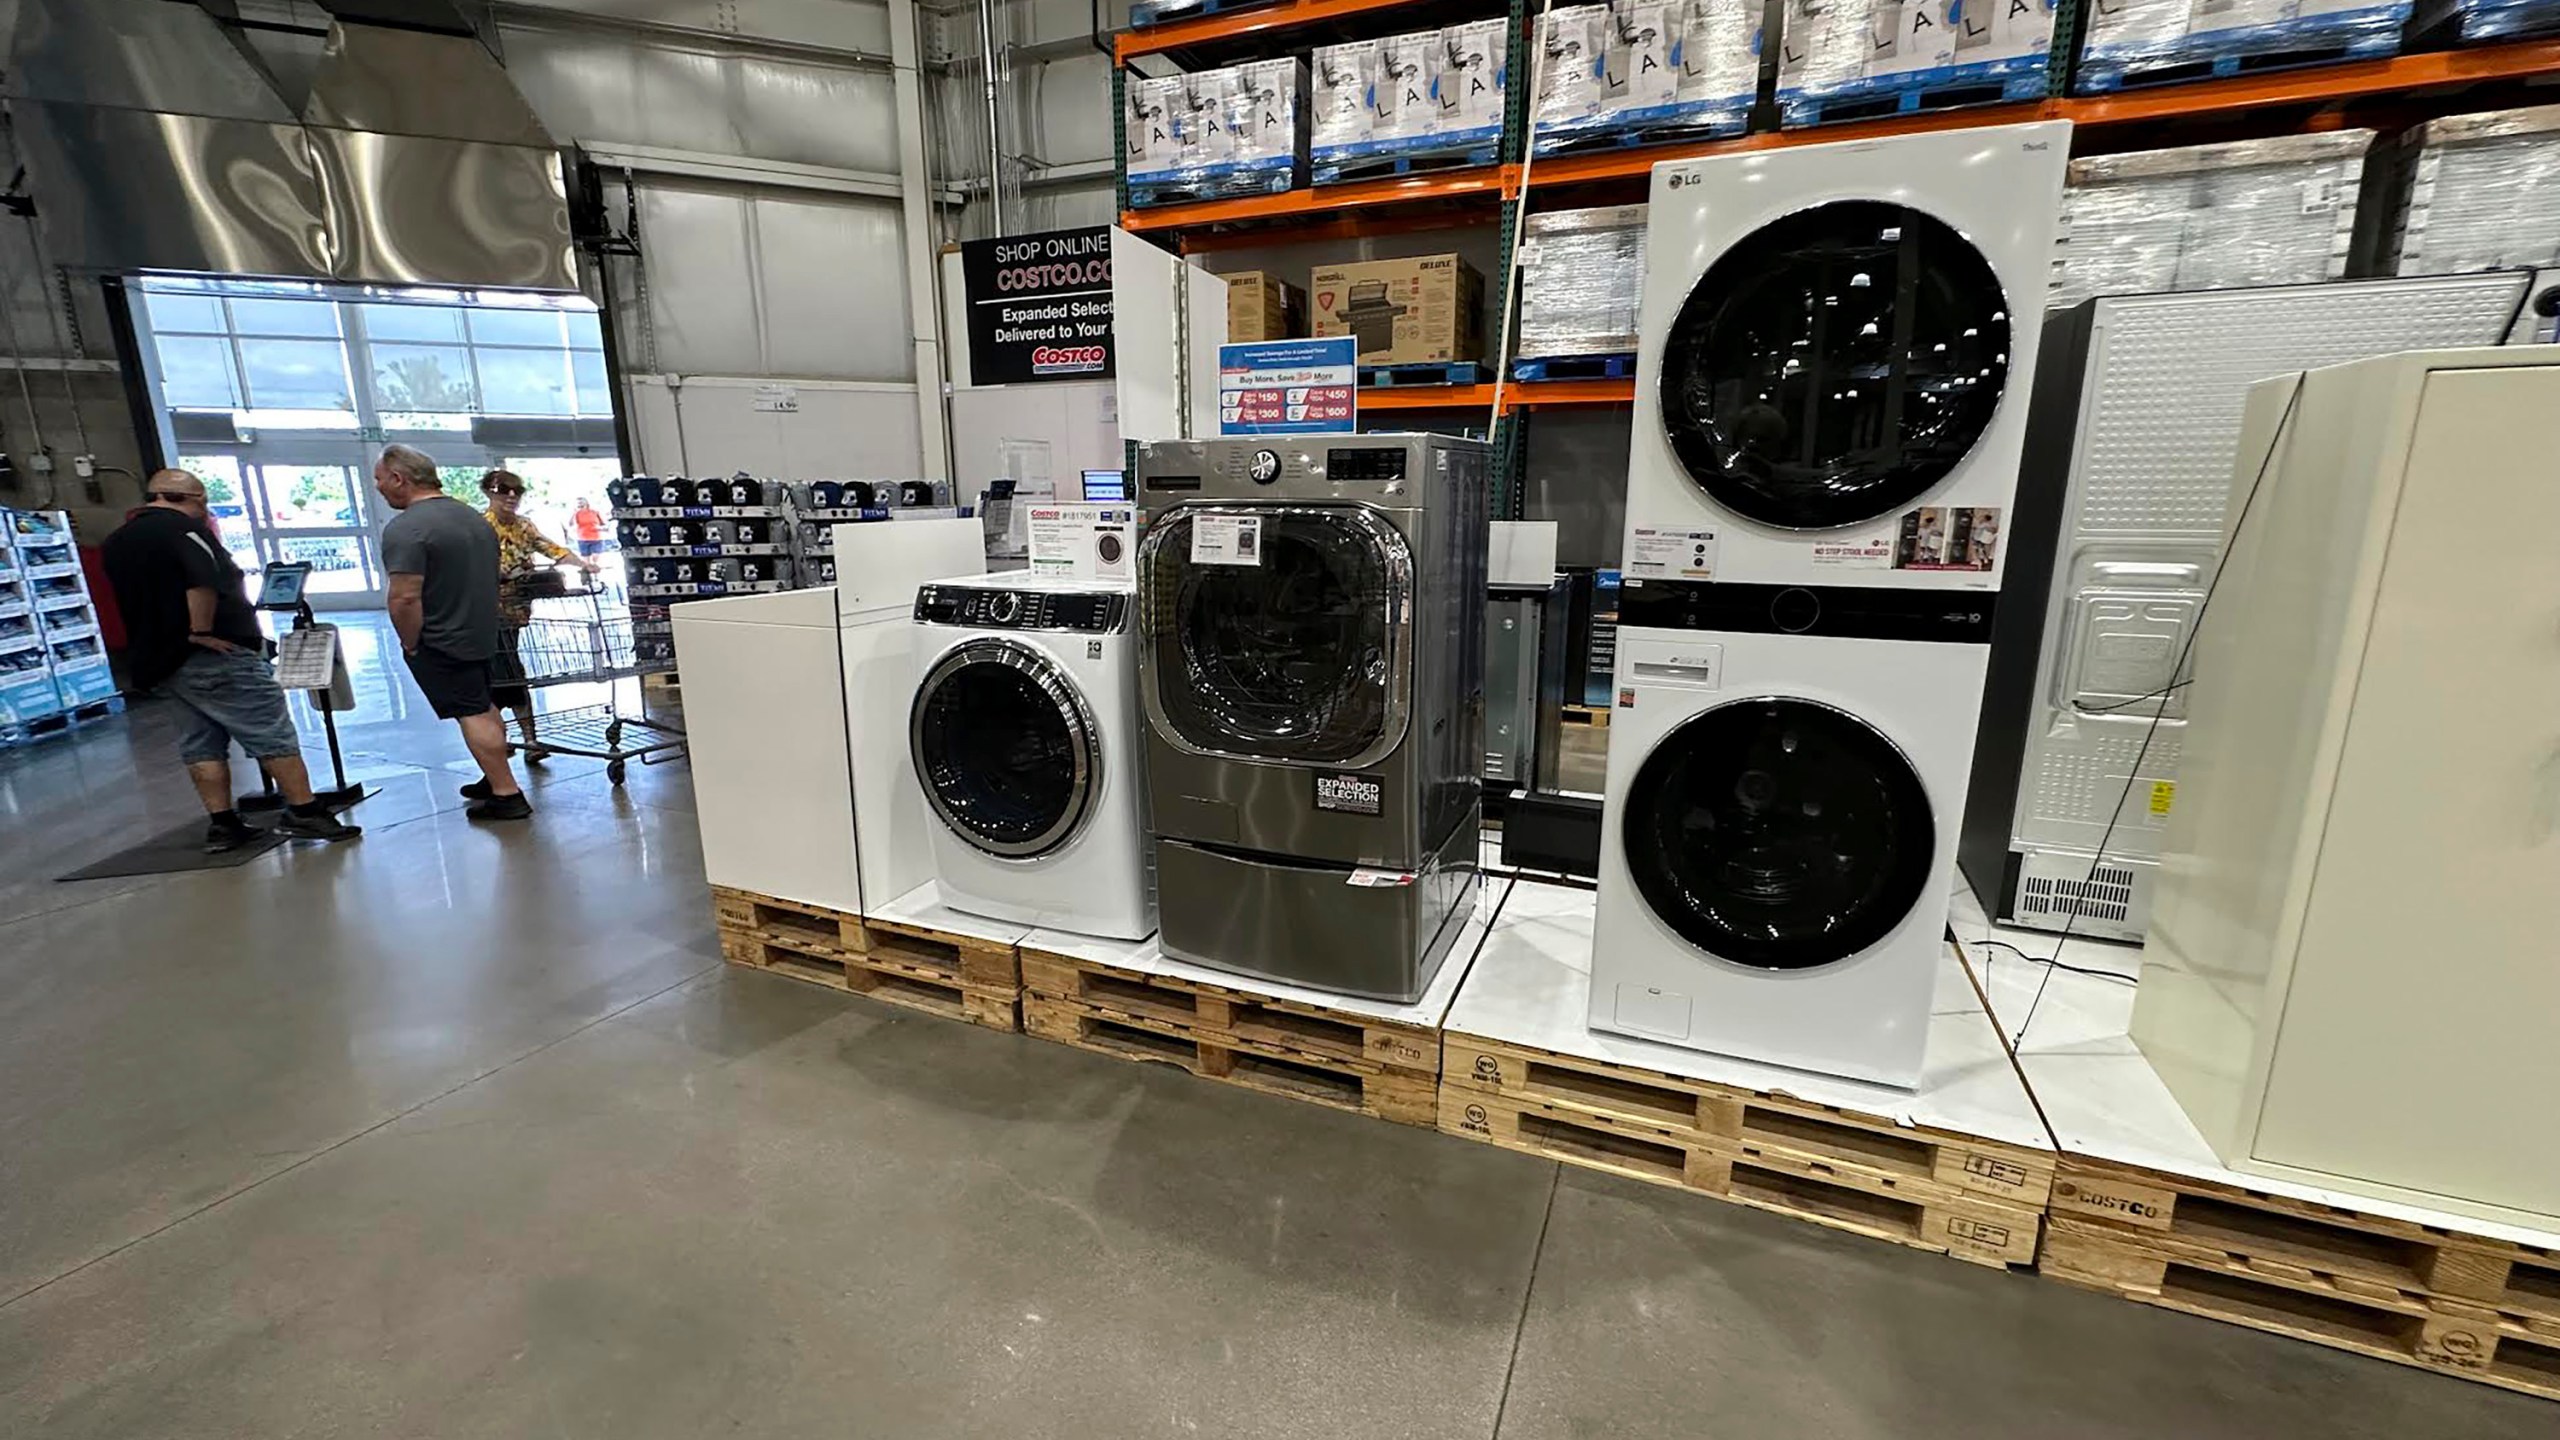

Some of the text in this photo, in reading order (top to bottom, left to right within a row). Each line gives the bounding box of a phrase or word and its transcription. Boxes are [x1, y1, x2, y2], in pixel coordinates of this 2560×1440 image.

[1685, 174, 1701, 186] LG
[996, 234, 1109, 263] SHOP ONLINE
[1002, 303, 1068, 324] Expanded
[995, 321, 1108, 343] Delivered to Your
[1032, 345, 1106, 366] COSTCO
[685, 508, 711, 516] TITAN
[1317, 778, 1380, 793] EXPANDED
[1317, 787, 1380, 802] SELECTION
[2080, 1192, 2158, 1219] COSTCO
